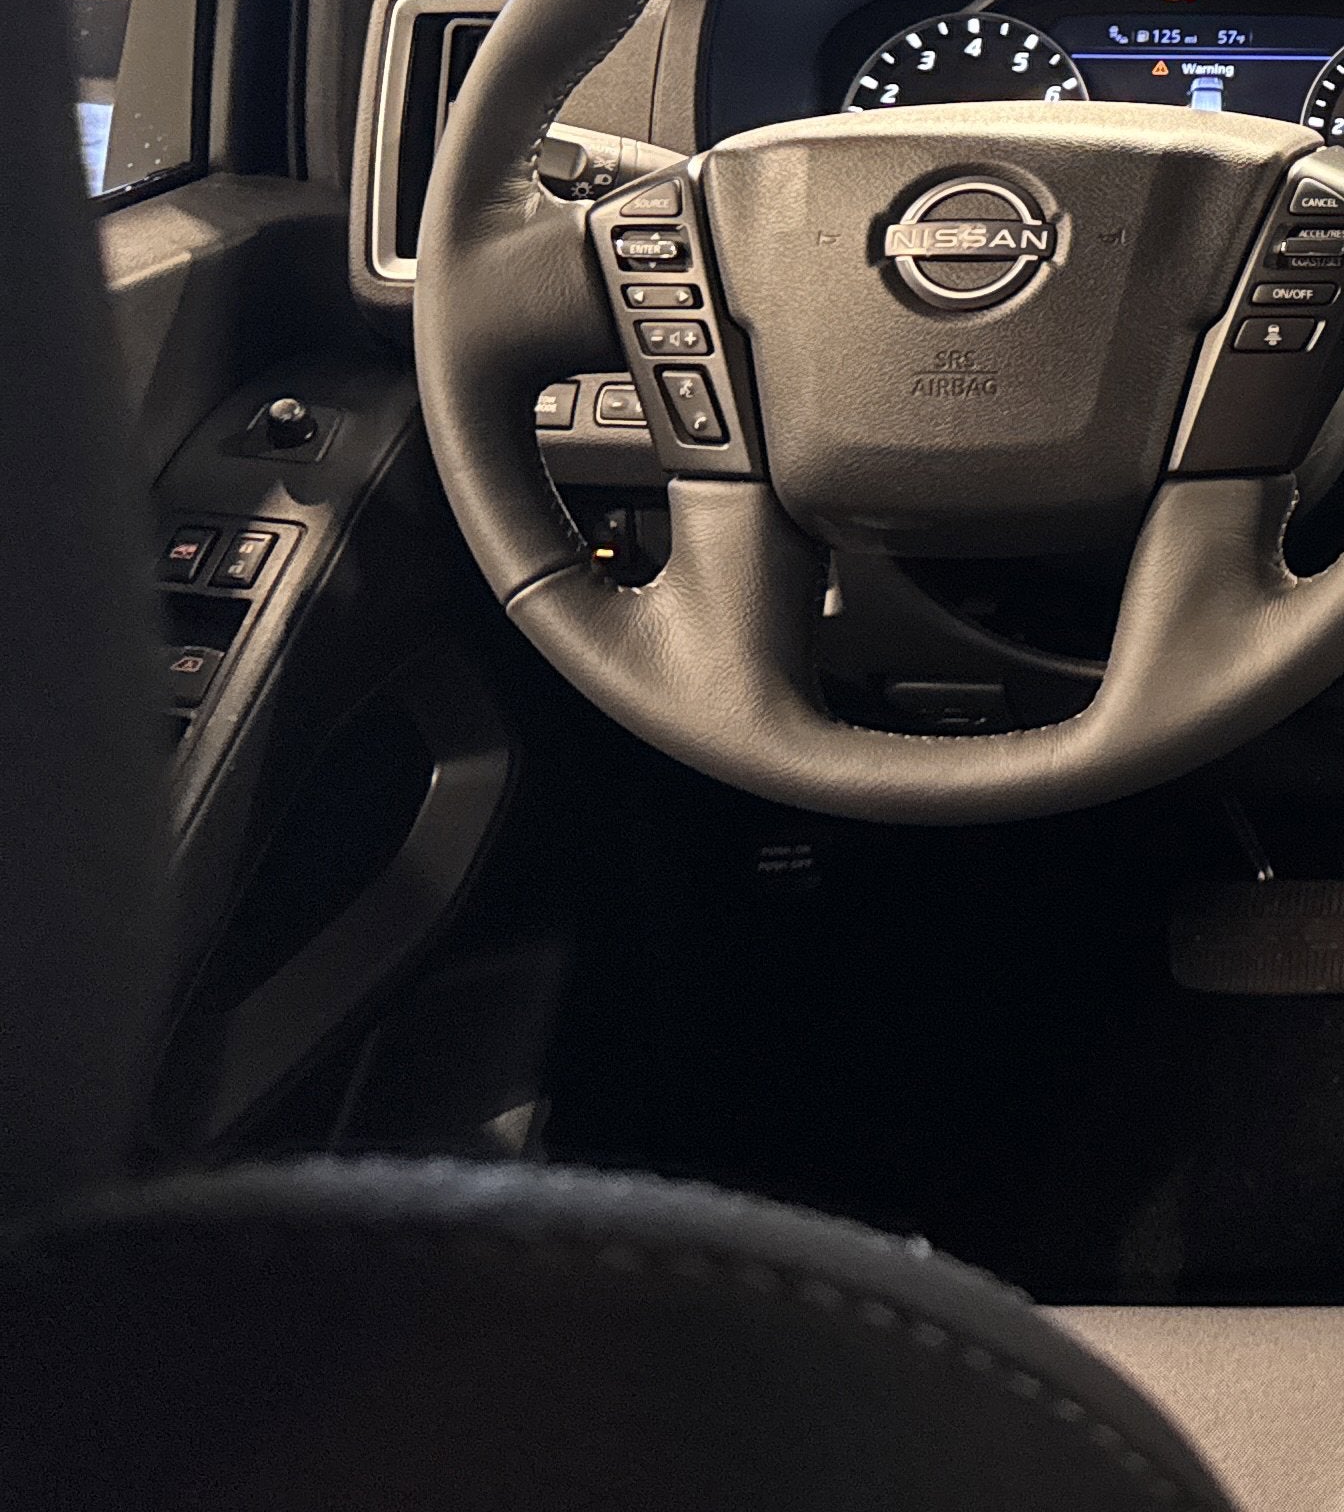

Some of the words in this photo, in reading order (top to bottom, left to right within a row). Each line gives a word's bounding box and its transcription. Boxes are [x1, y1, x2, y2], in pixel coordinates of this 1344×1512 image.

[1152, 29, 1181, 44] 125
[964, 38, 982, 57] 4
[917, 50, 936, 71] 3
[1011, 52, 1030, 73] 5
[1181, 63, 1235, 77] Warning
[880, 84, 899, 104] 2
[1044, 85, 1061, 103] 6
[634, 199, 669, 208] SOURCE
[1302, 198, 1338, 208] CANCEL
[892, 228, 1048, 250] NISSAN
[629, 244, 660, 255] ENTER
[1273, 289, 1313, 299] ON/OFF
[936, 350, 977, 369] SRS
[911, 377, 998, 397] AIRBAG
